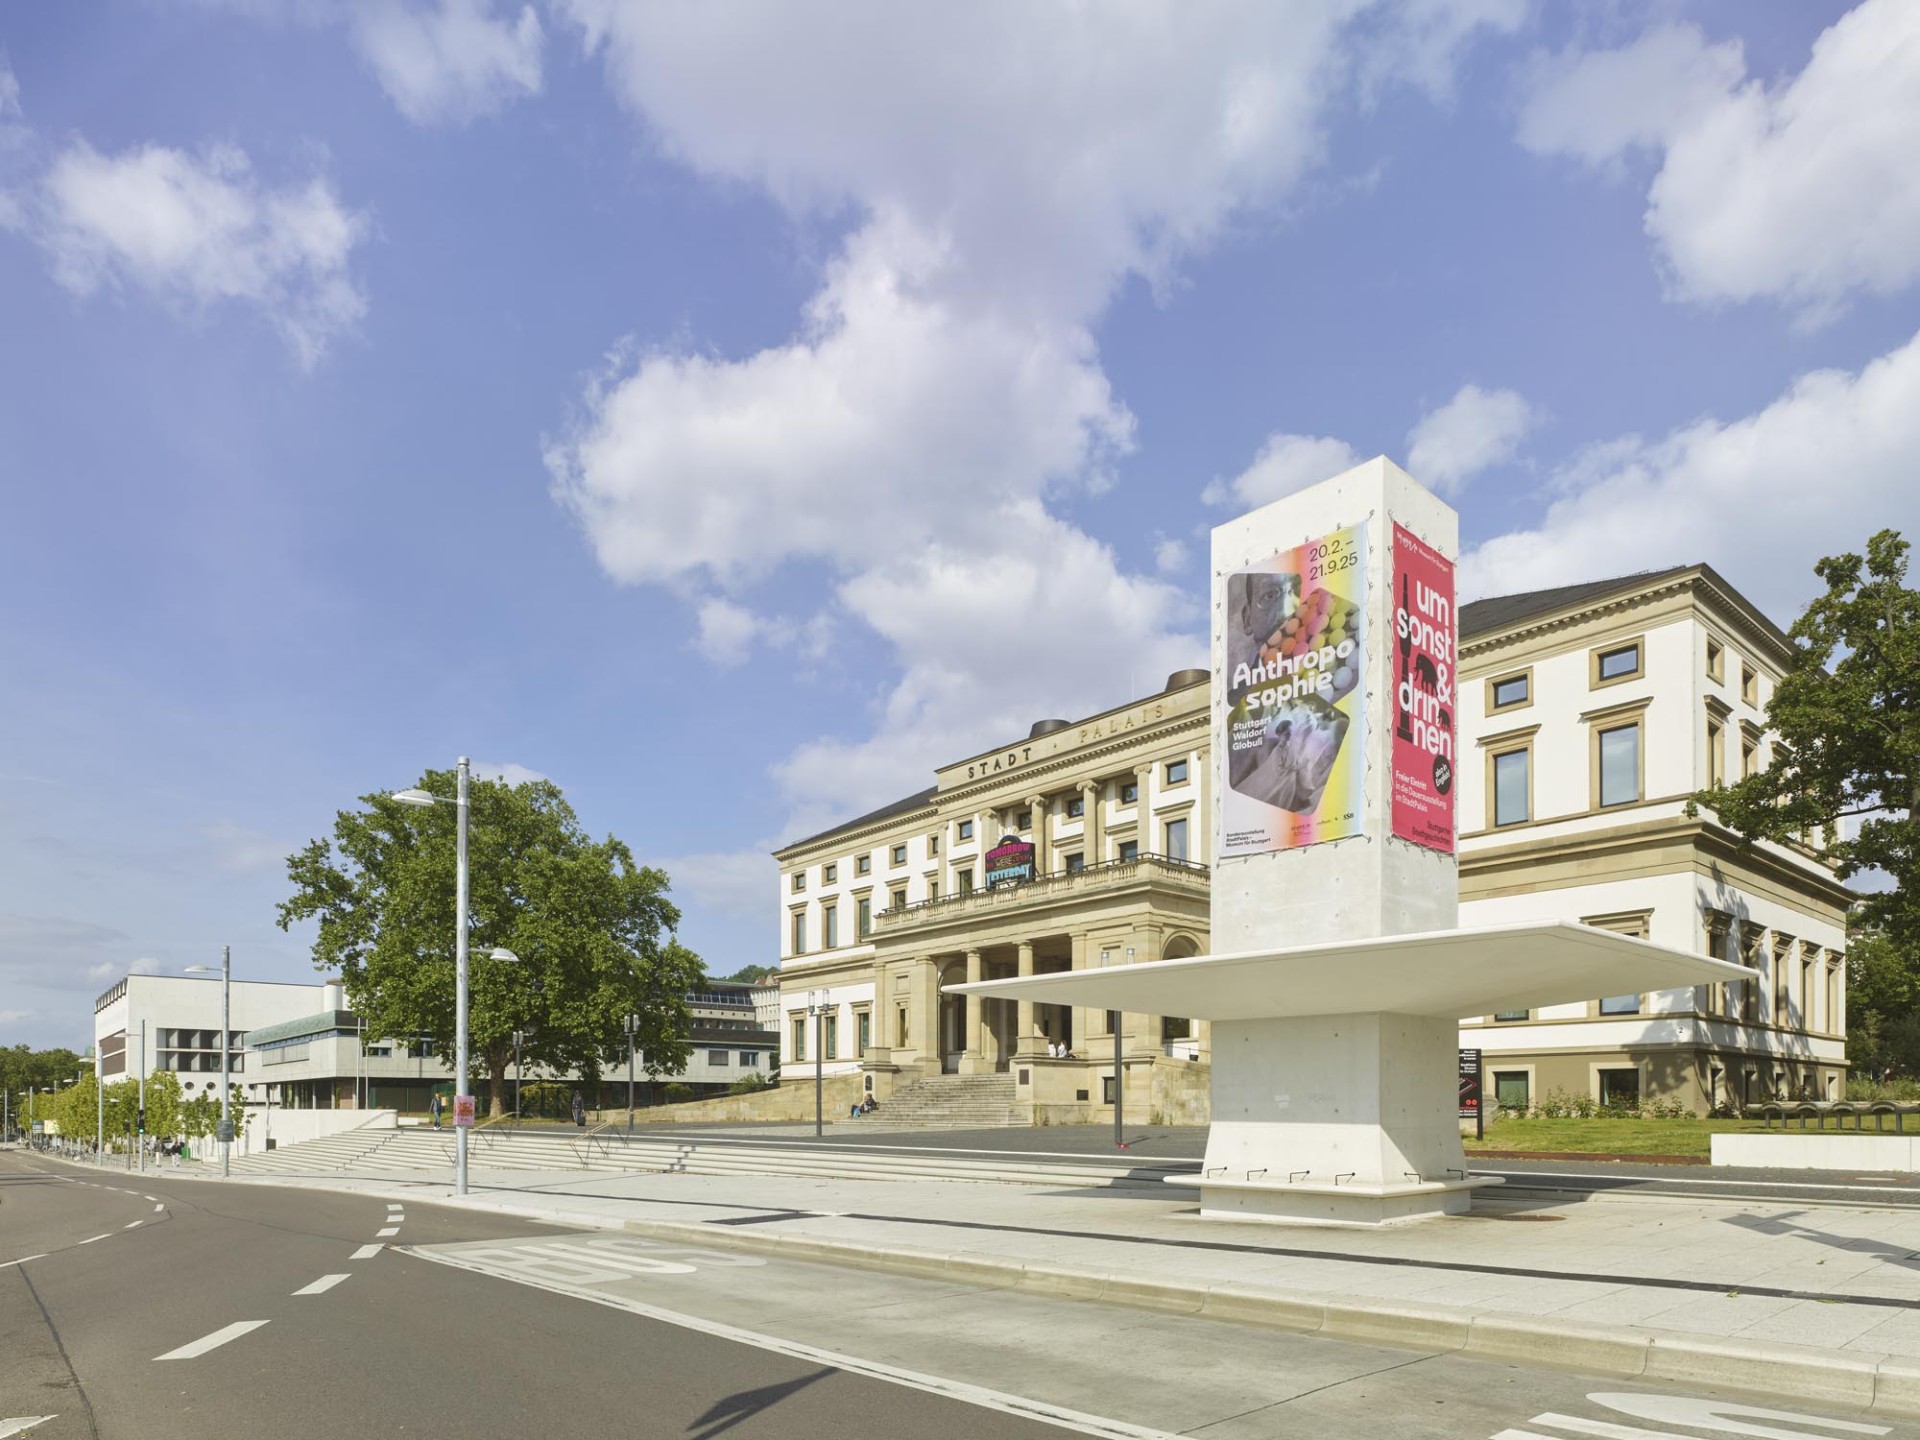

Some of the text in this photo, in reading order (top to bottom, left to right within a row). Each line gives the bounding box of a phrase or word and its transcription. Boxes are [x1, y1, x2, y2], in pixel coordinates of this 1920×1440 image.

[1310, 551, 1358, 581] 21.9.25
[1416, 580, 1449, 627] um
[1397, 607, 1452, 665] sonst
[1232, 638, 1356, 690] Anthropo
[1437, 662, 1452, 706] &
[1245, 671, 1333, 711] sophie
[1399, 672, 1440, 727] drin
[968, 705, 1164, 779] STADT PALAIS
[1232, 715, 1272, 731] Stuttgart
[1232, 725, 1268, 741] Waldorf
[1232, 736, 1263, 751] Globuli
[1413, 717, 1452, 760] nen
[986, 843, 1030, 859] TOMORROW
[445, 1238, 767, 1285] BUS
